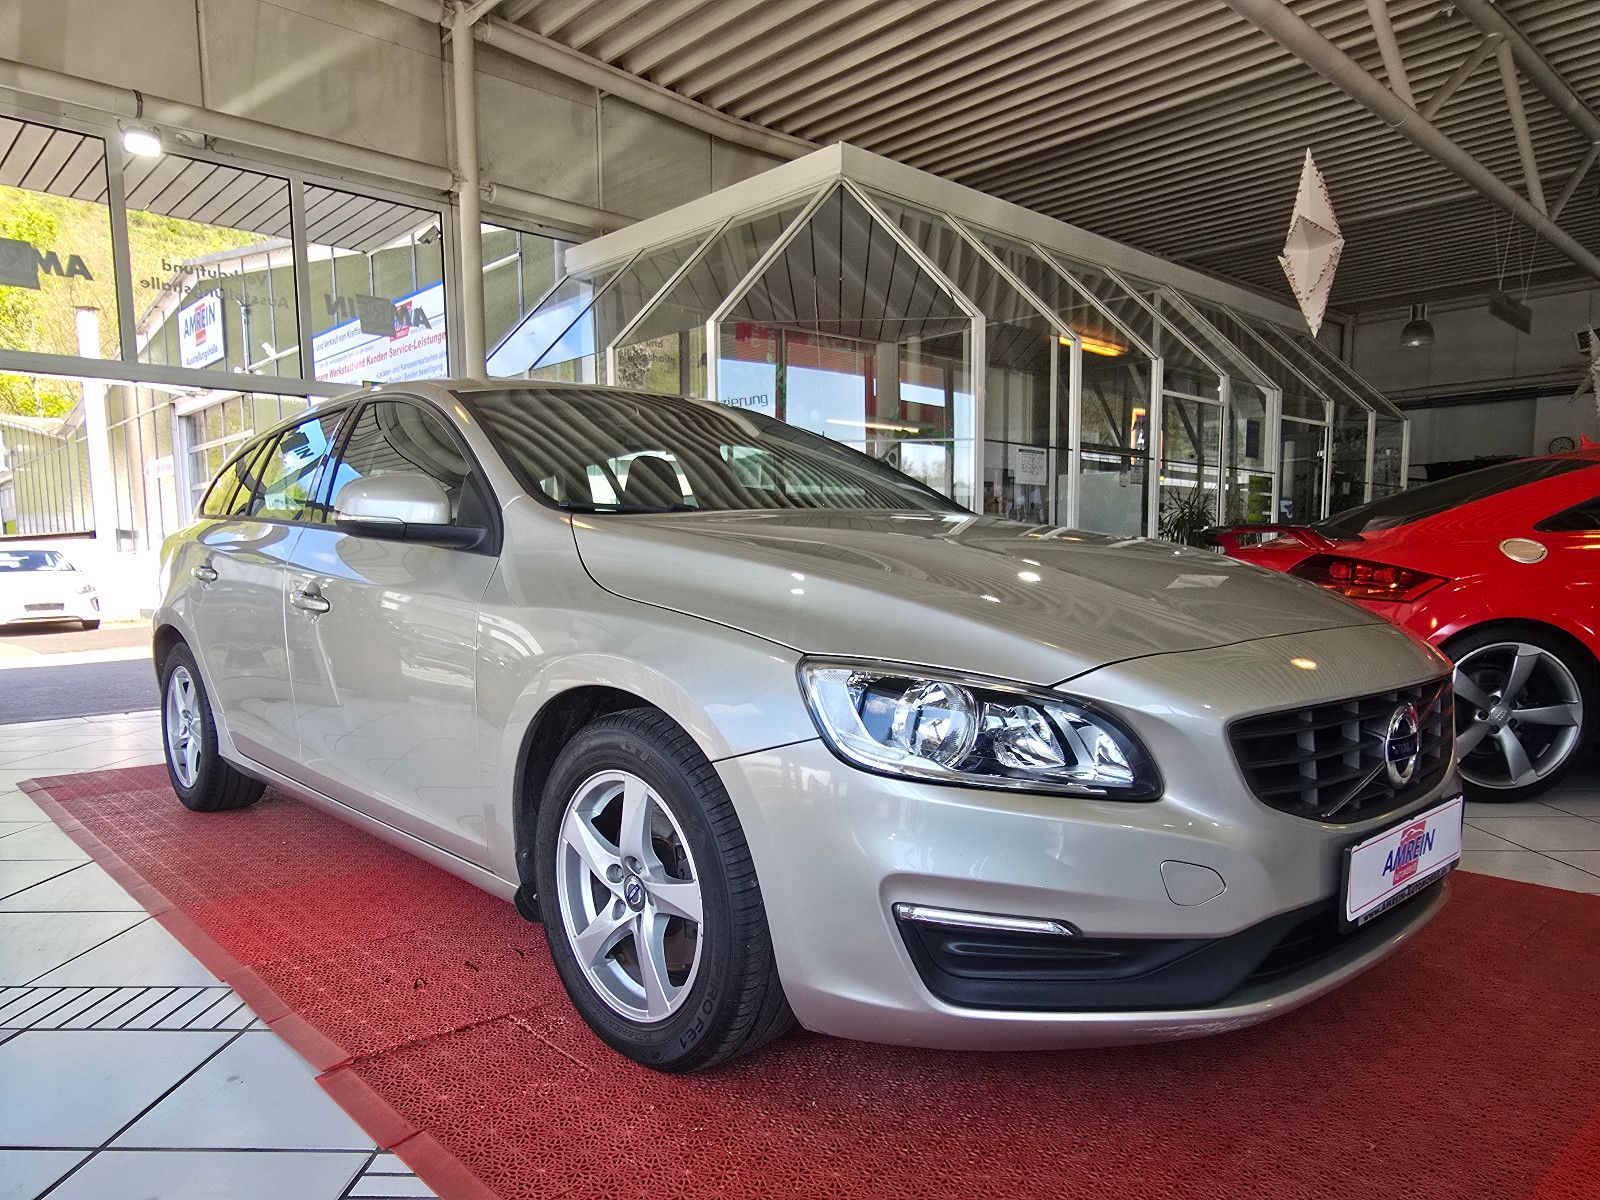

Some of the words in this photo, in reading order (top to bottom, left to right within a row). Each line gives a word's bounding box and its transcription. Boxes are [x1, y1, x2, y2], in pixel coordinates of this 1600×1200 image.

[183, 302, 216, 339] AMREIN
[366, 351, 388, 366] Kunden
[1381, 829, 1436, 877] AMREIN
